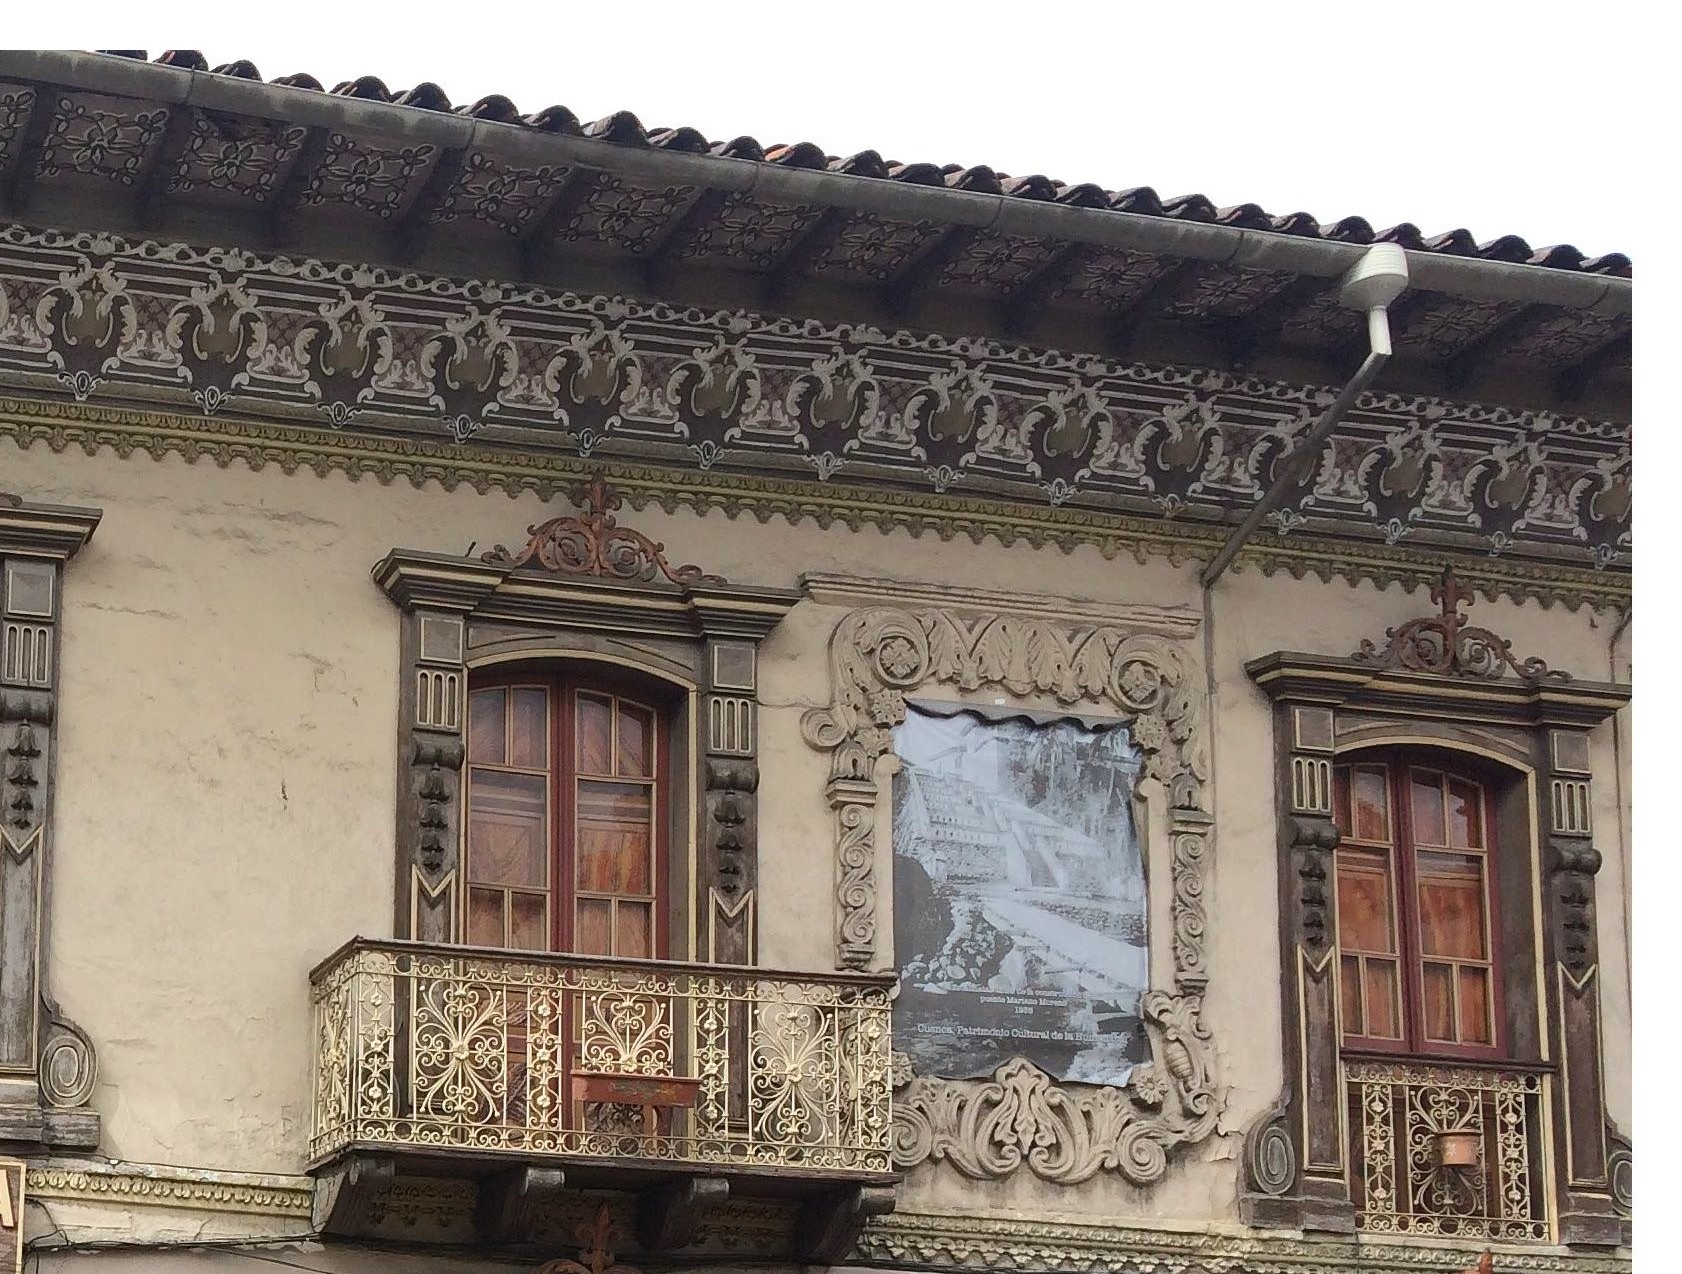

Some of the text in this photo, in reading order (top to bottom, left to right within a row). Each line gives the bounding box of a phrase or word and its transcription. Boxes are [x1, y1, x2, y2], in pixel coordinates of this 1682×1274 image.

[1011, 1028, 1050, 1039] Cultural
[1051, 1031, 1064, 1040] de
[1065, 1031, 1074, 1040] la
